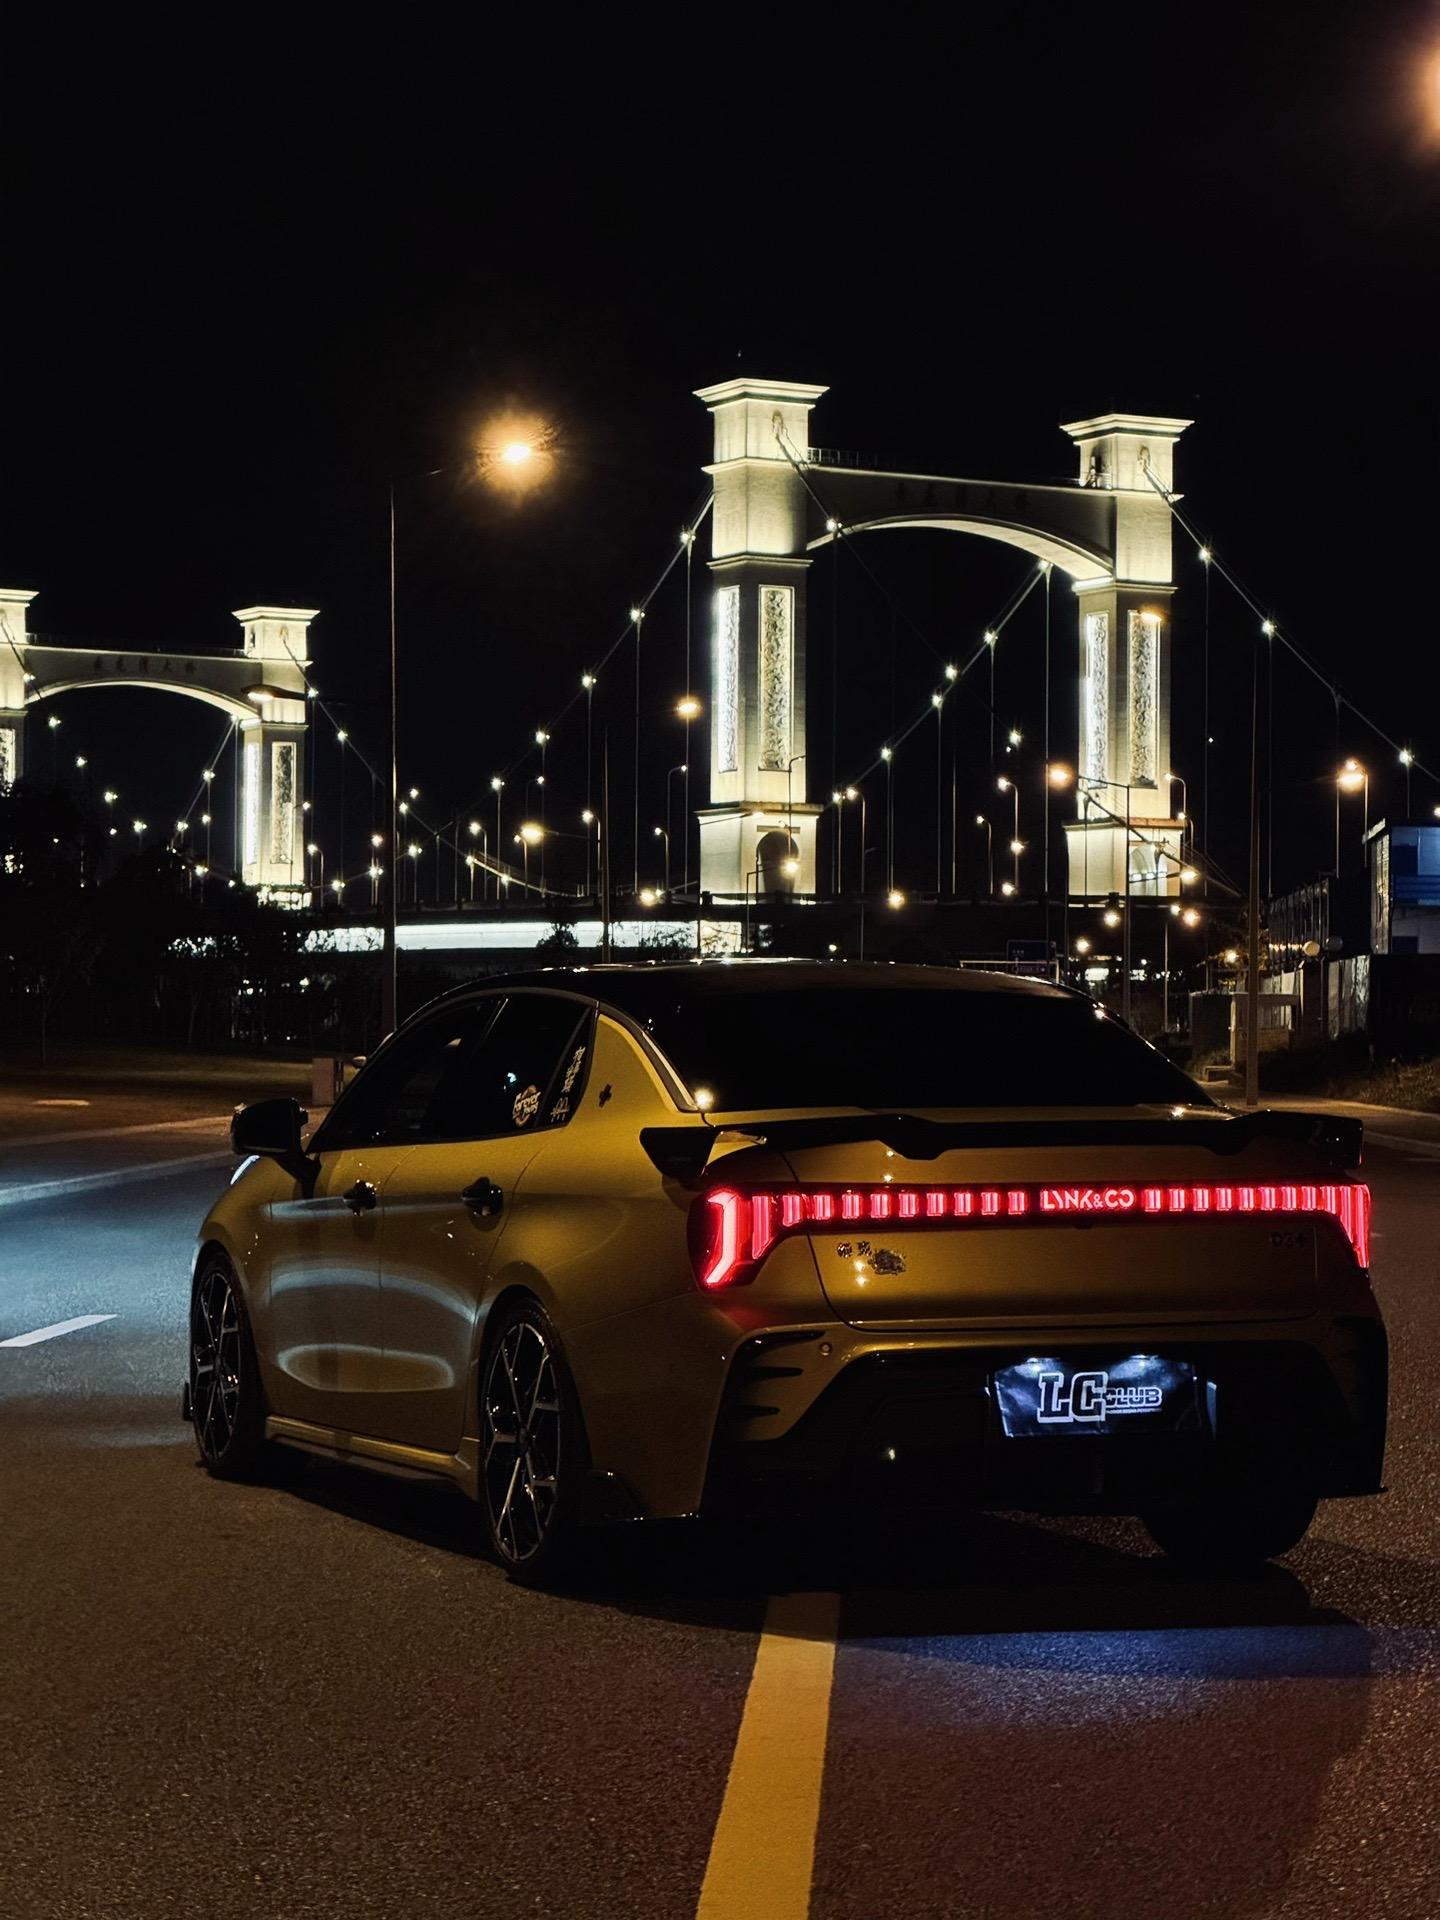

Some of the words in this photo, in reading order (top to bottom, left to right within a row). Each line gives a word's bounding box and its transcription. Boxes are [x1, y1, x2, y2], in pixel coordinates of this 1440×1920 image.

[1043, 1189, 1135, 1209] LYNK&CO
[1037, 1371, 1109, 1423] LC
[1105, 1386, 1163, 1408] CLUB
